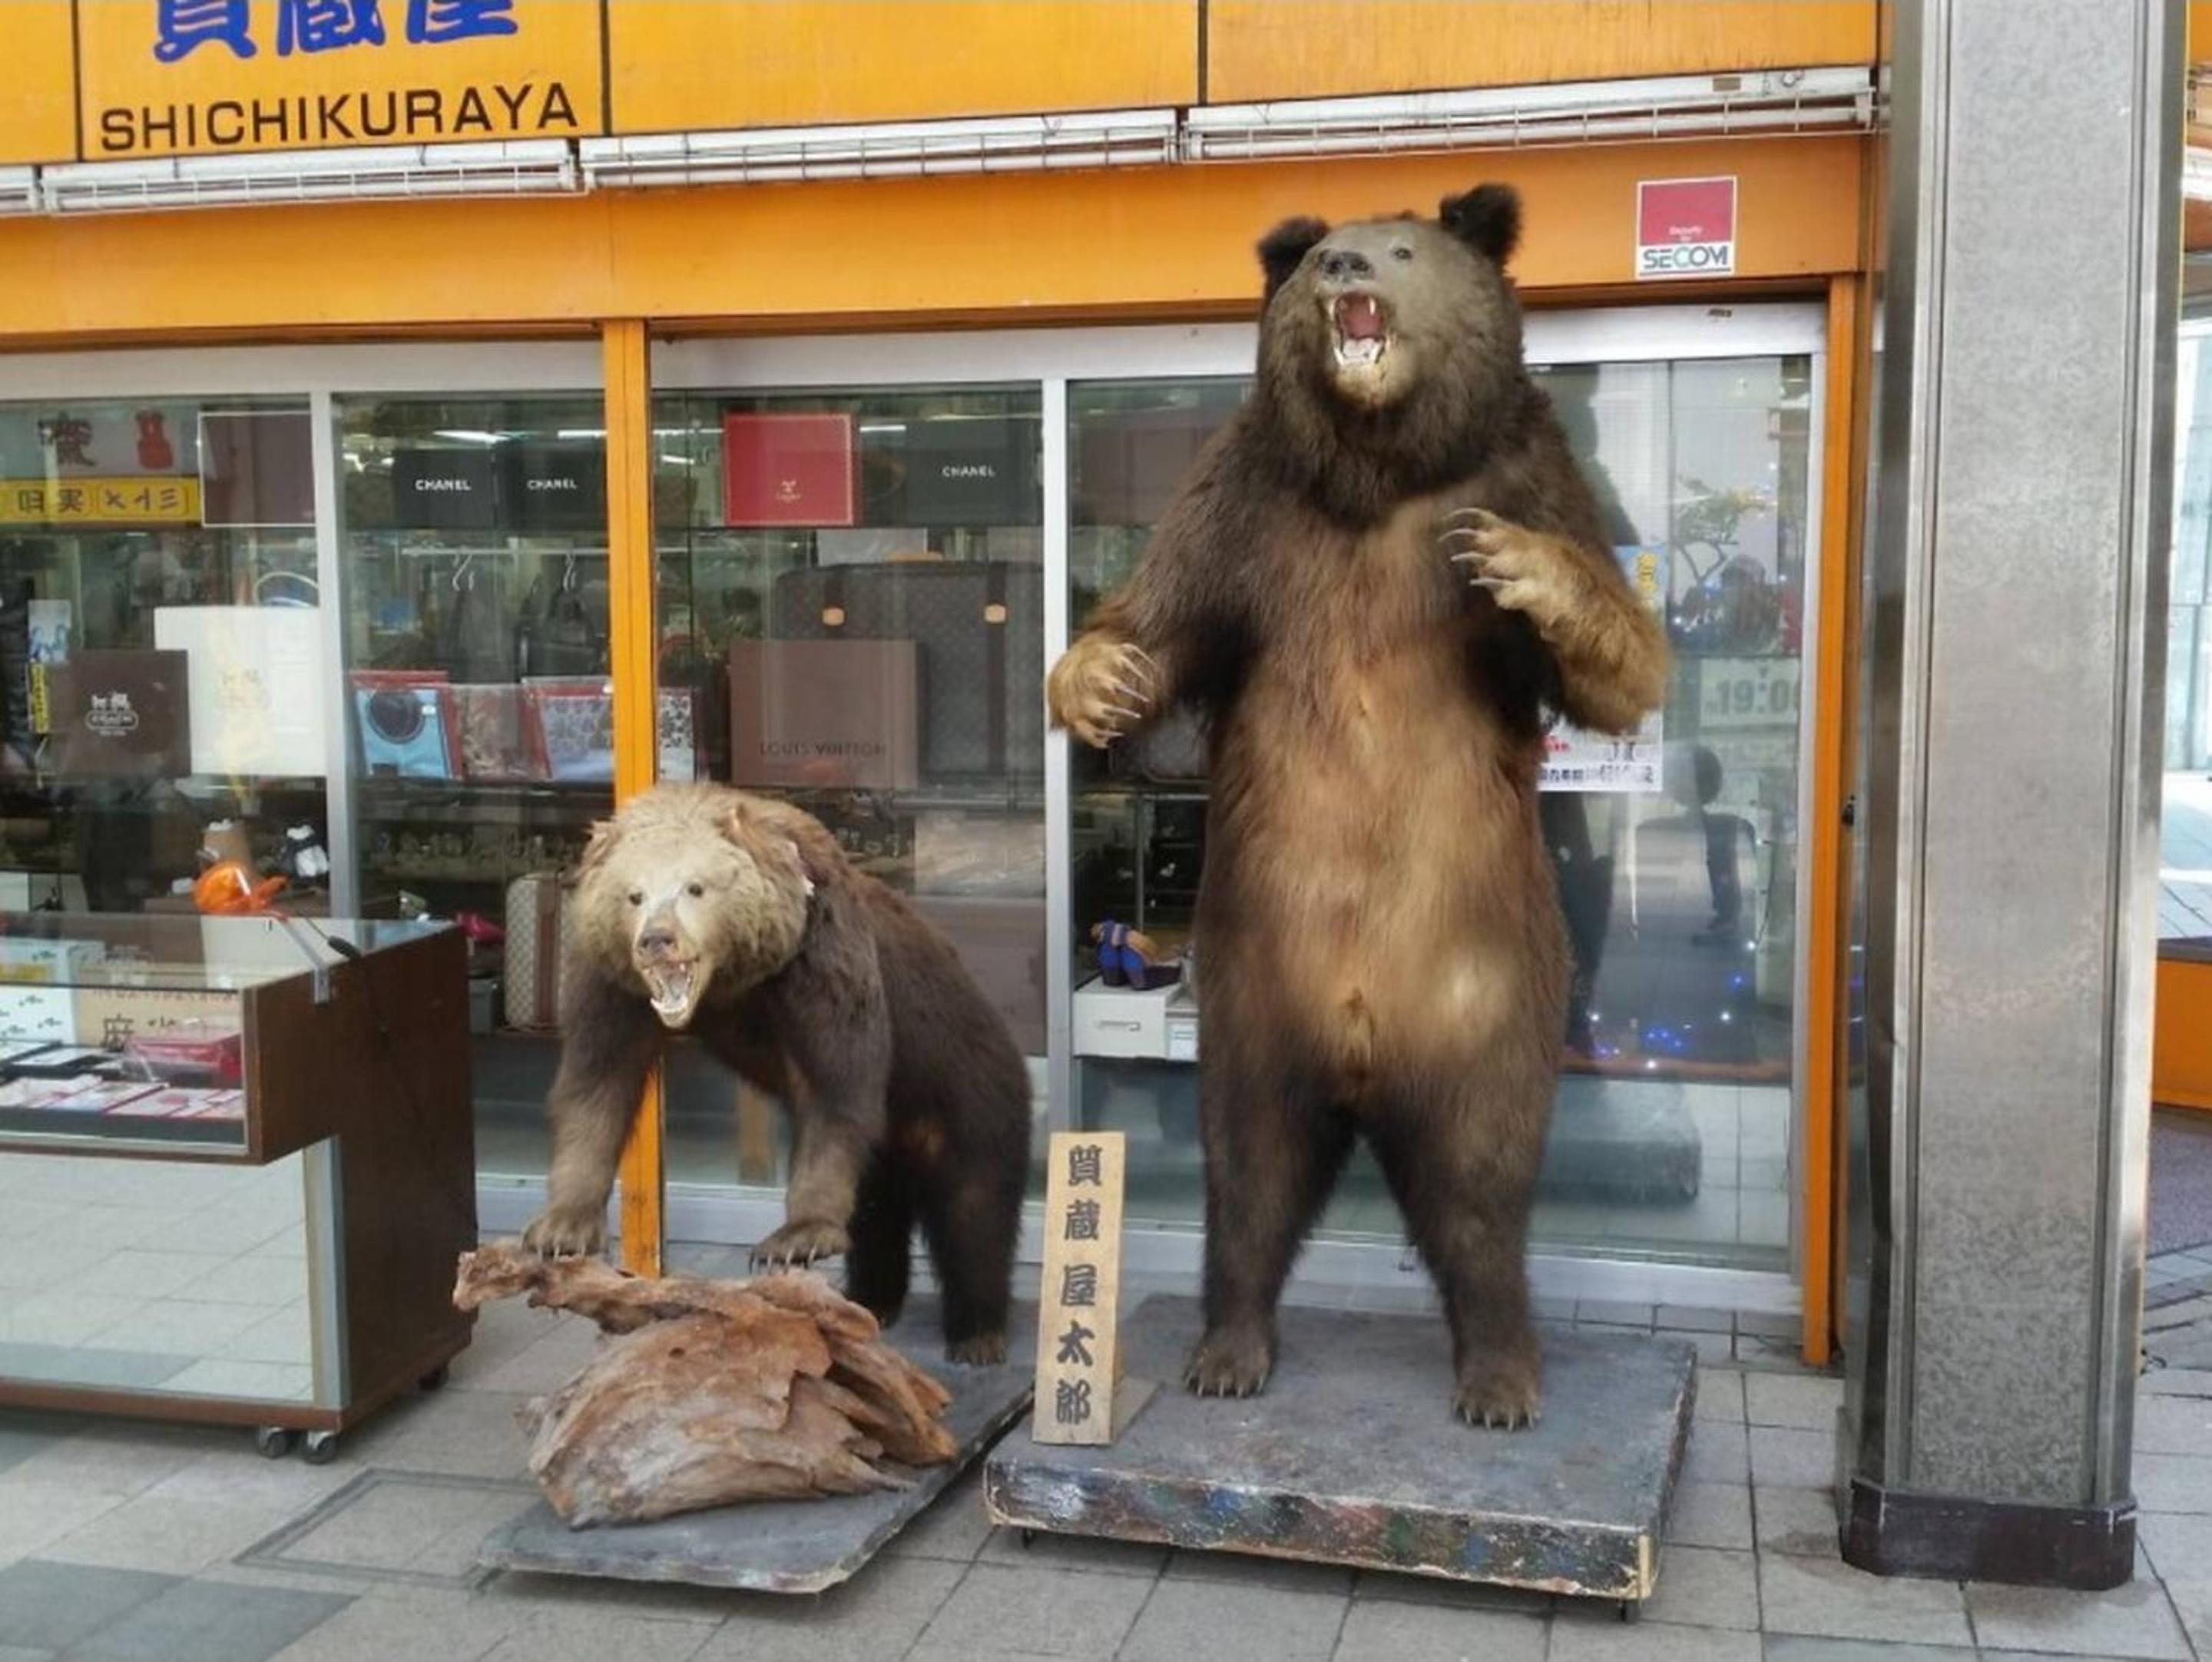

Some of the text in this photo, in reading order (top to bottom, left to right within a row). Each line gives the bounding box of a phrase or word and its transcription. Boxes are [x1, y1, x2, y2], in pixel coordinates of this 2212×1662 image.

[101, 81, 578, 151] SHICHIKURAYA
[1642, 245, 1729, 270] SECOM
[526, 478, 578, 490] CHANEL
[942, 465, 995, 478] CHANEL
[415, 478, 472, 492] CHANEL
[1715, 679, 1799, 716] 19:0
[1055, 1144, 1104, 1425] 質蔵屋太郎
